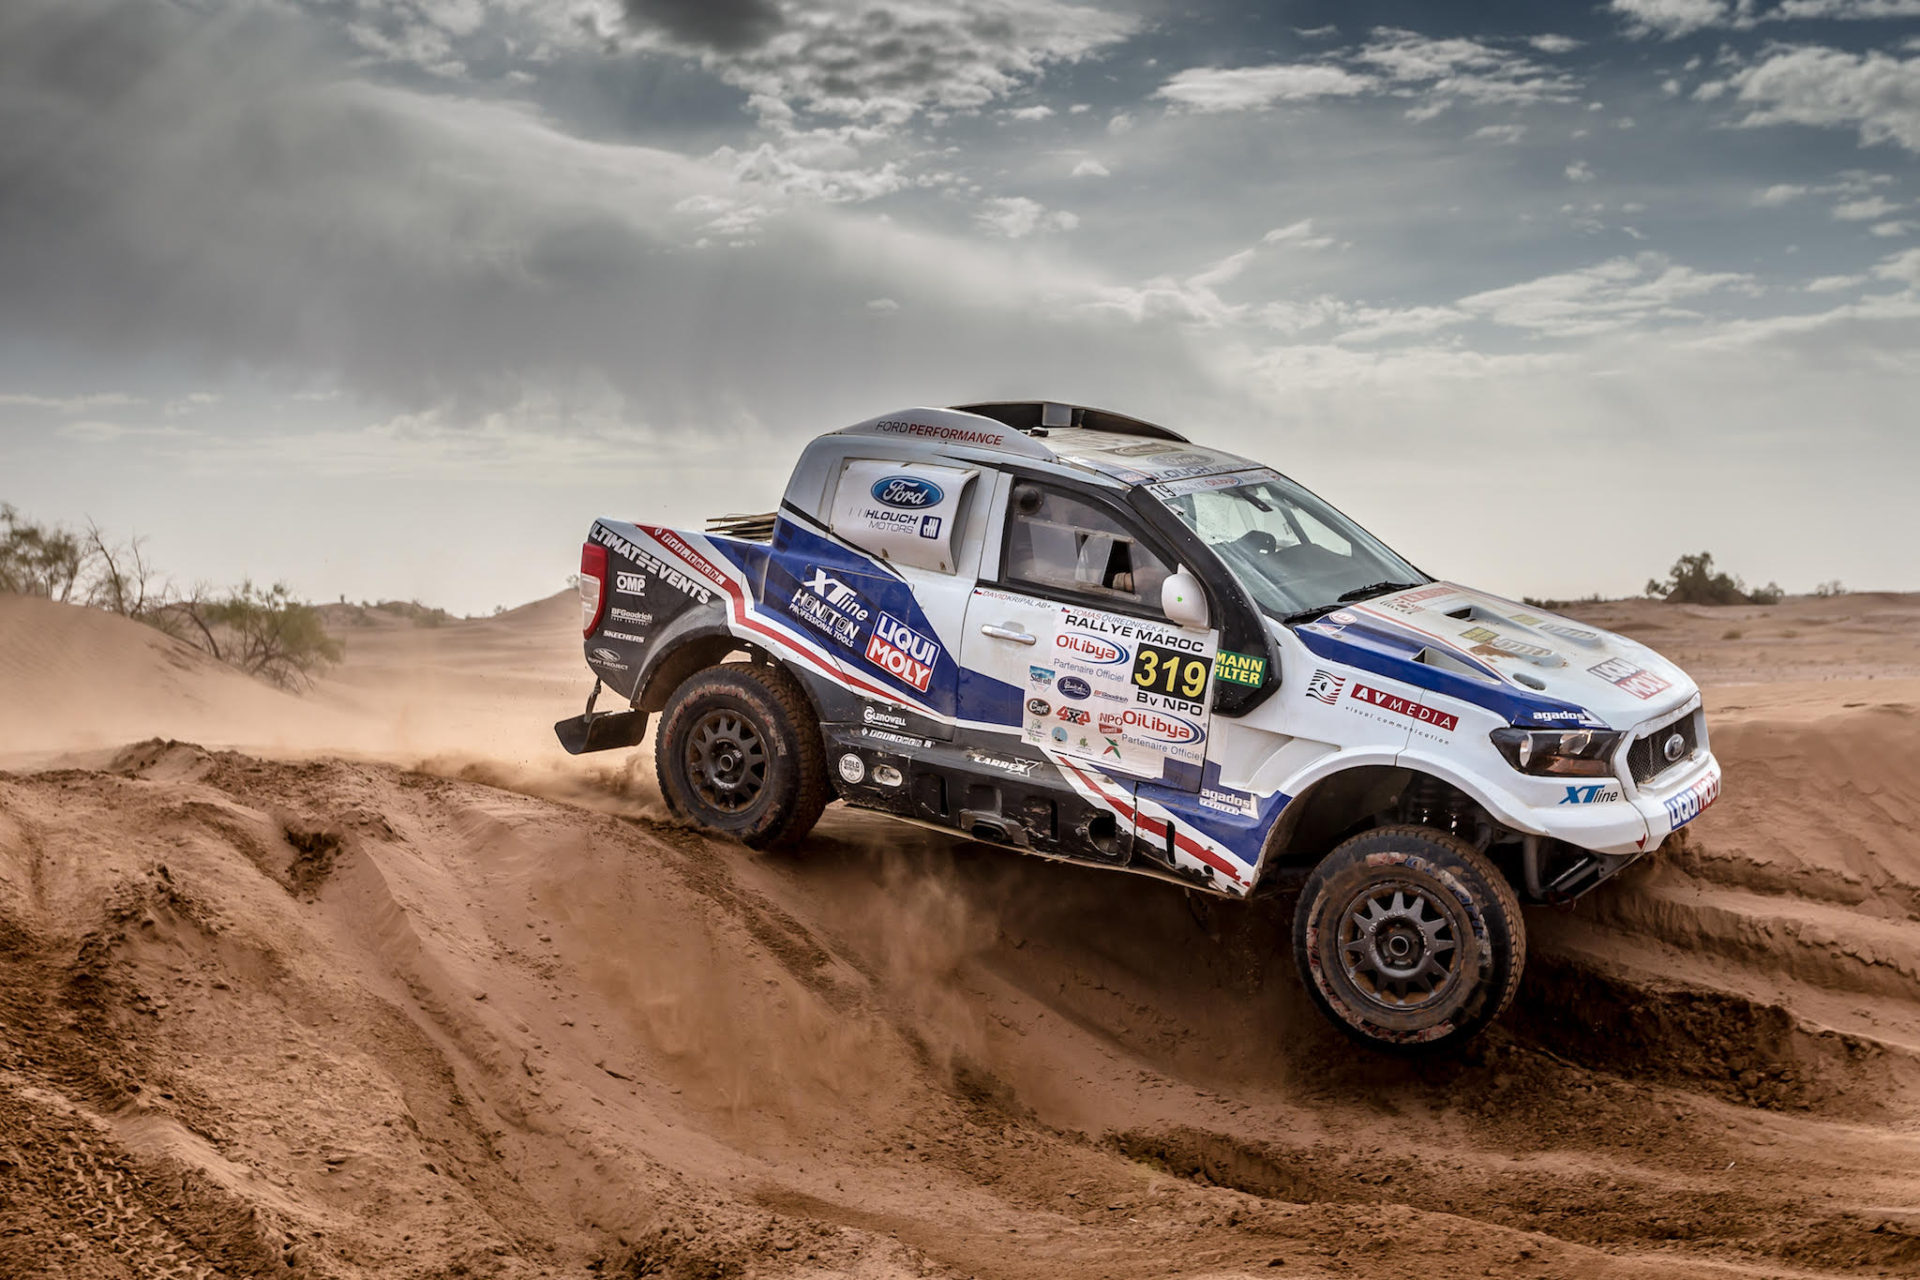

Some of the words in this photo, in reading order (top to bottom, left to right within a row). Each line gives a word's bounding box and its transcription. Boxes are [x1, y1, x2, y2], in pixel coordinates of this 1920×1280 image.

[882, 479, 929, 505] Ford
[866, 509, 919, 525] HLOUCH
[867, 520, 915, 534] MOTORS
[616, 574, 646, 593] OMP
[803, 567, 869, 621] XTline
[611, 607, 653, 621] BFGoodrich
[788, 602, 834, 636] PROFESSIONAL
[832, 630, 855, 648] TOOLS
[791, 588, 861, 640] HONITON
[603, 629, 645, 643] SKECHERS
[875, 614, 937, 666] LIQUI
[1064, 614, 1133, 638] RALLYE
[1135, 629, 1205, 653] MAROC
[1056, 634, 1116, 660] OiLibya
[868, 638, 931, 687] MOLY
[1054, 658, 1094, 676] Partenaire
[1095, 668, 1125, 682] Officiel
[1134, 649, 1207, 698] 319
[1214, 664, 1261, 685] FILTER
[1215, 651, 1263, 673] MANN
[1136, 691, 1158, 706] Bv
[1162, 697, 1203, 716] NPO
[1533, 710, 1585, 722] agados
[1099, 712, 1123, 726] NPO
[1122, 710, 1190, 739] OiLibya
[1345, 705, 1374, 719] visual
[1376, 715, 1450, 746] communication
[1121, 733, 1168, 753] Partenaire
[1170, 745, 1205, 762] Officiel
[1200, 787, 1251, 810] agados
[1558, 784, 1618, 805] XTline
